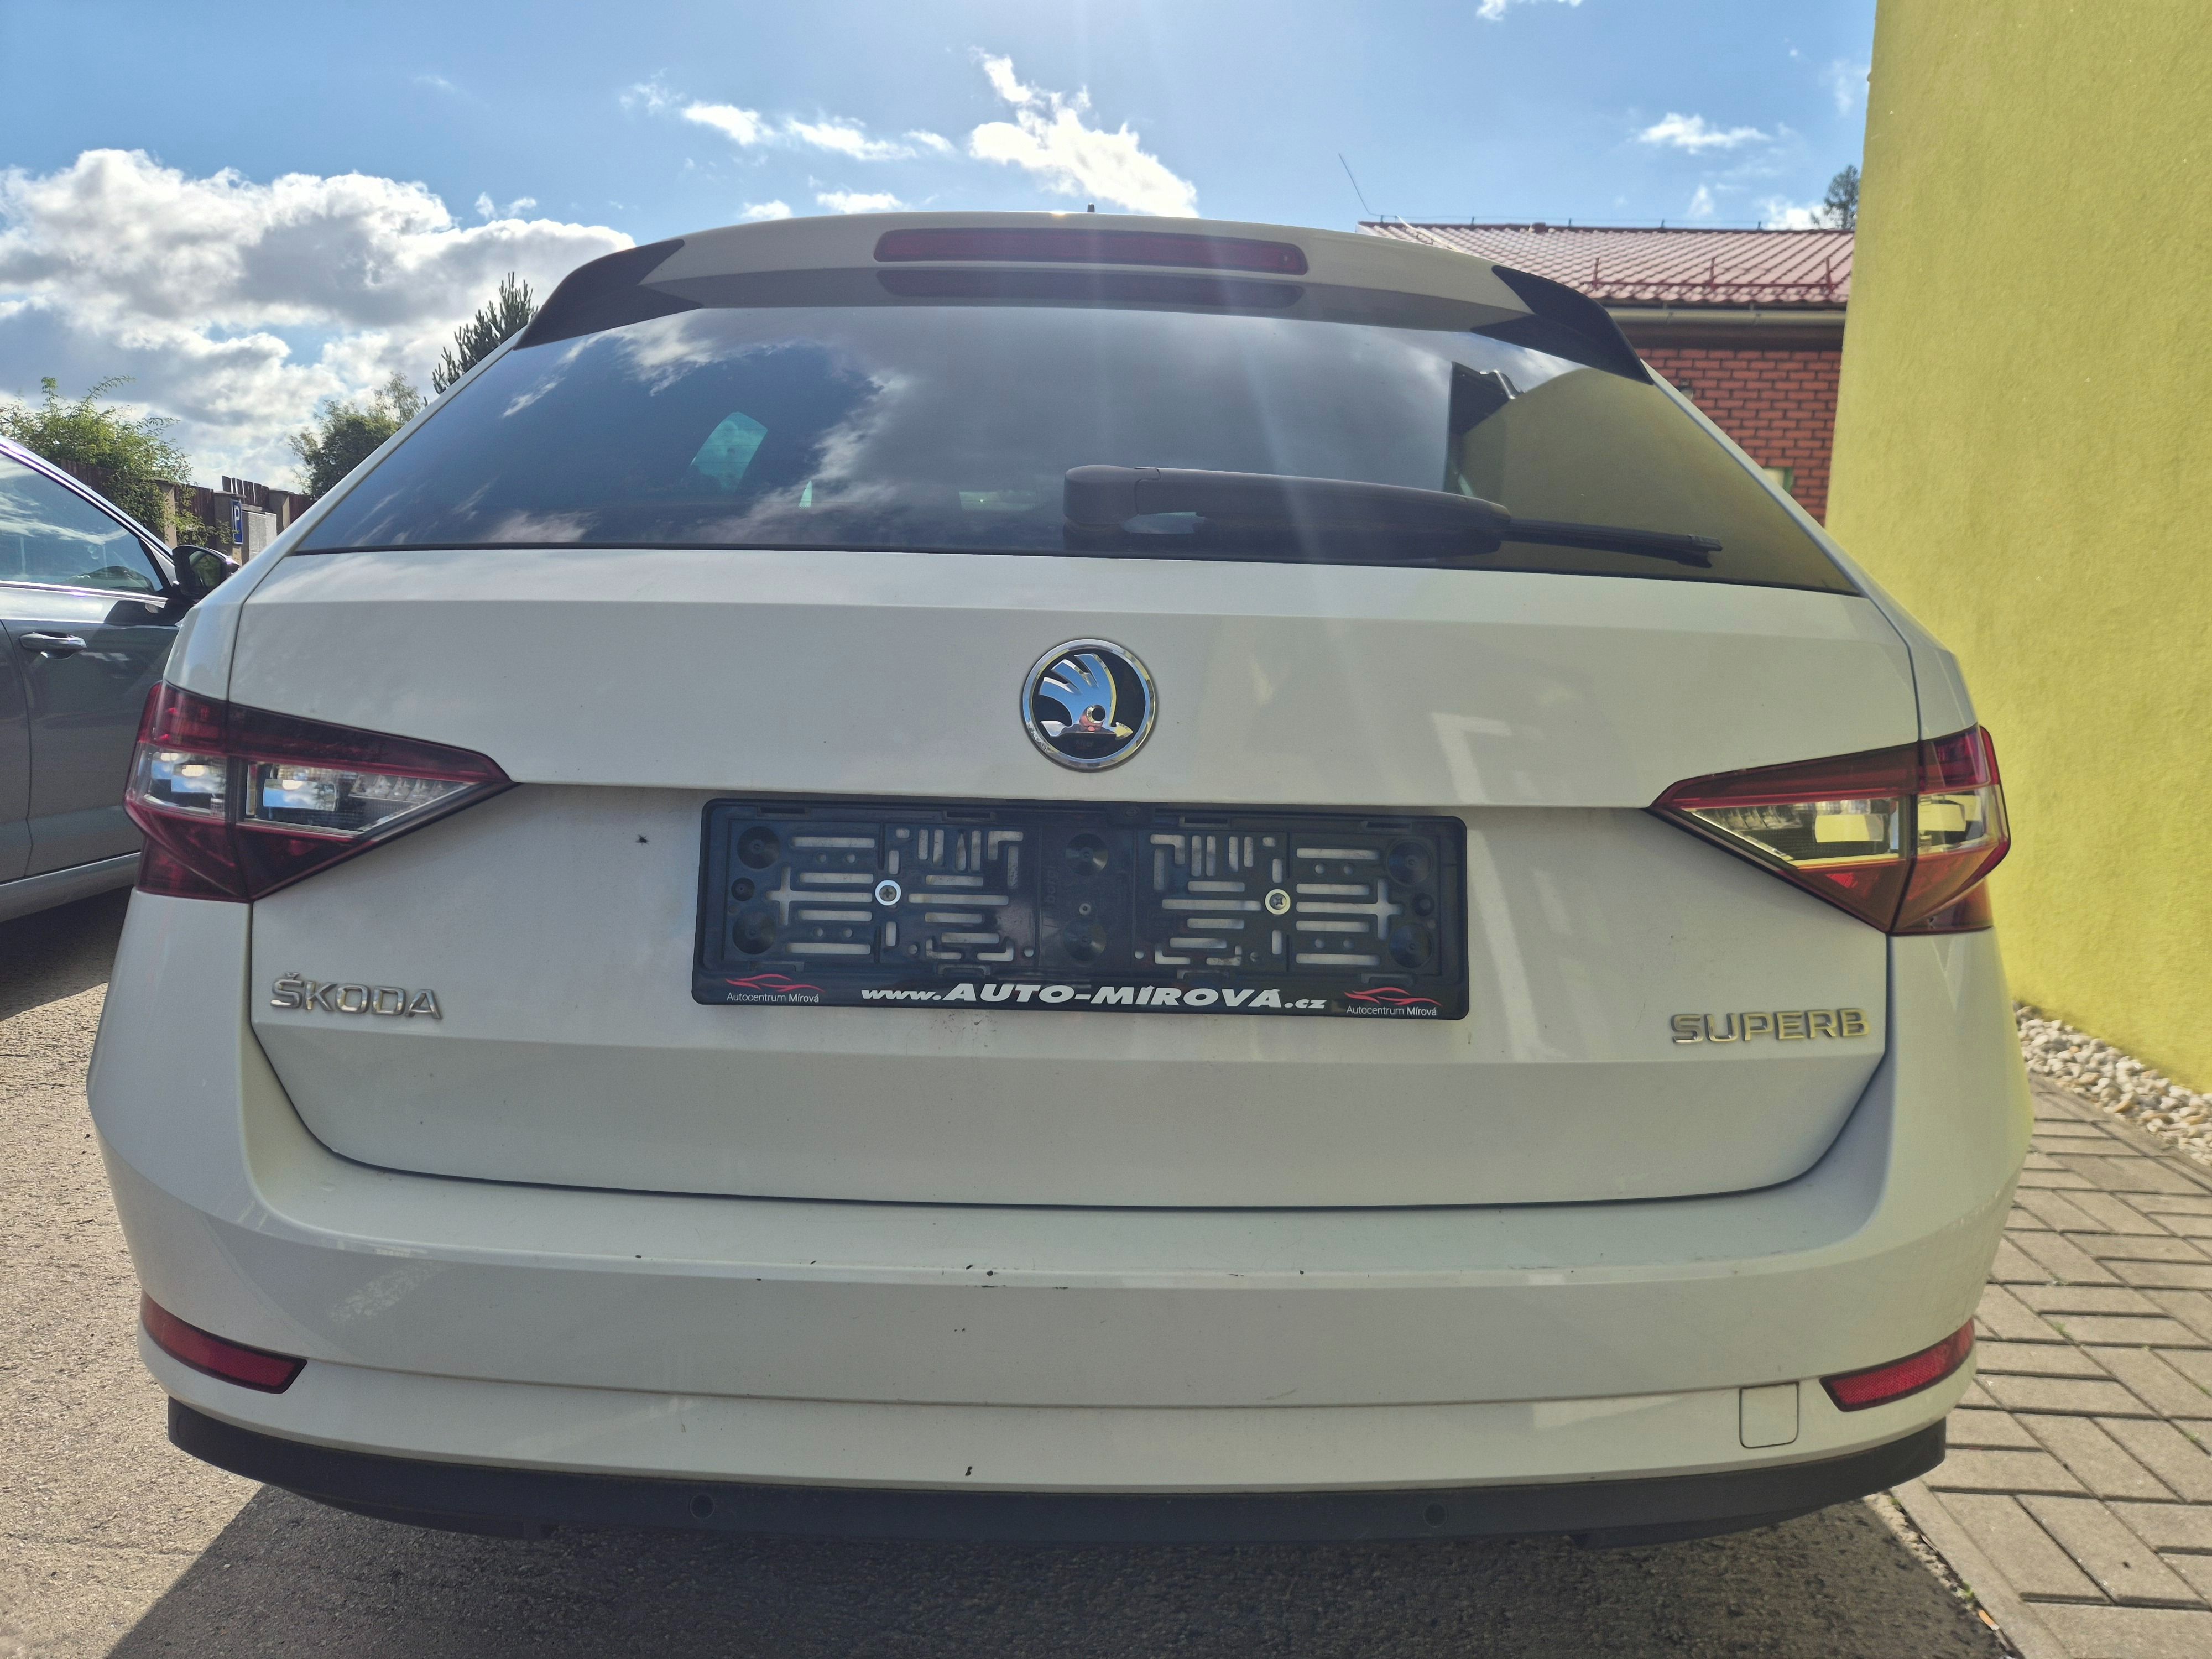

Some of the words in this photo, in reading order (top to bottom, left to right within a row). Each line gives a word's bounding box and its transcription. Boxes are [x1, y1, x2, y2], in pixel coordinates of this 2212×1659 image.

[234, 505, 240, 531] P
[270, 972, 442, 1019] ŠKODA
[727, 993, 786, 1002] Autocentrum
[789, 993, 819, 1003] Mírová
[861, 983, 1327, 1009] www.AUTO-MÍROVÁ.cz
[1346, 1005, 1404, 1015] Autocentrum
[1407, 1006, 1437, 1016] Mírová
[1671, 1008, 1870, 1044] SUPERB
